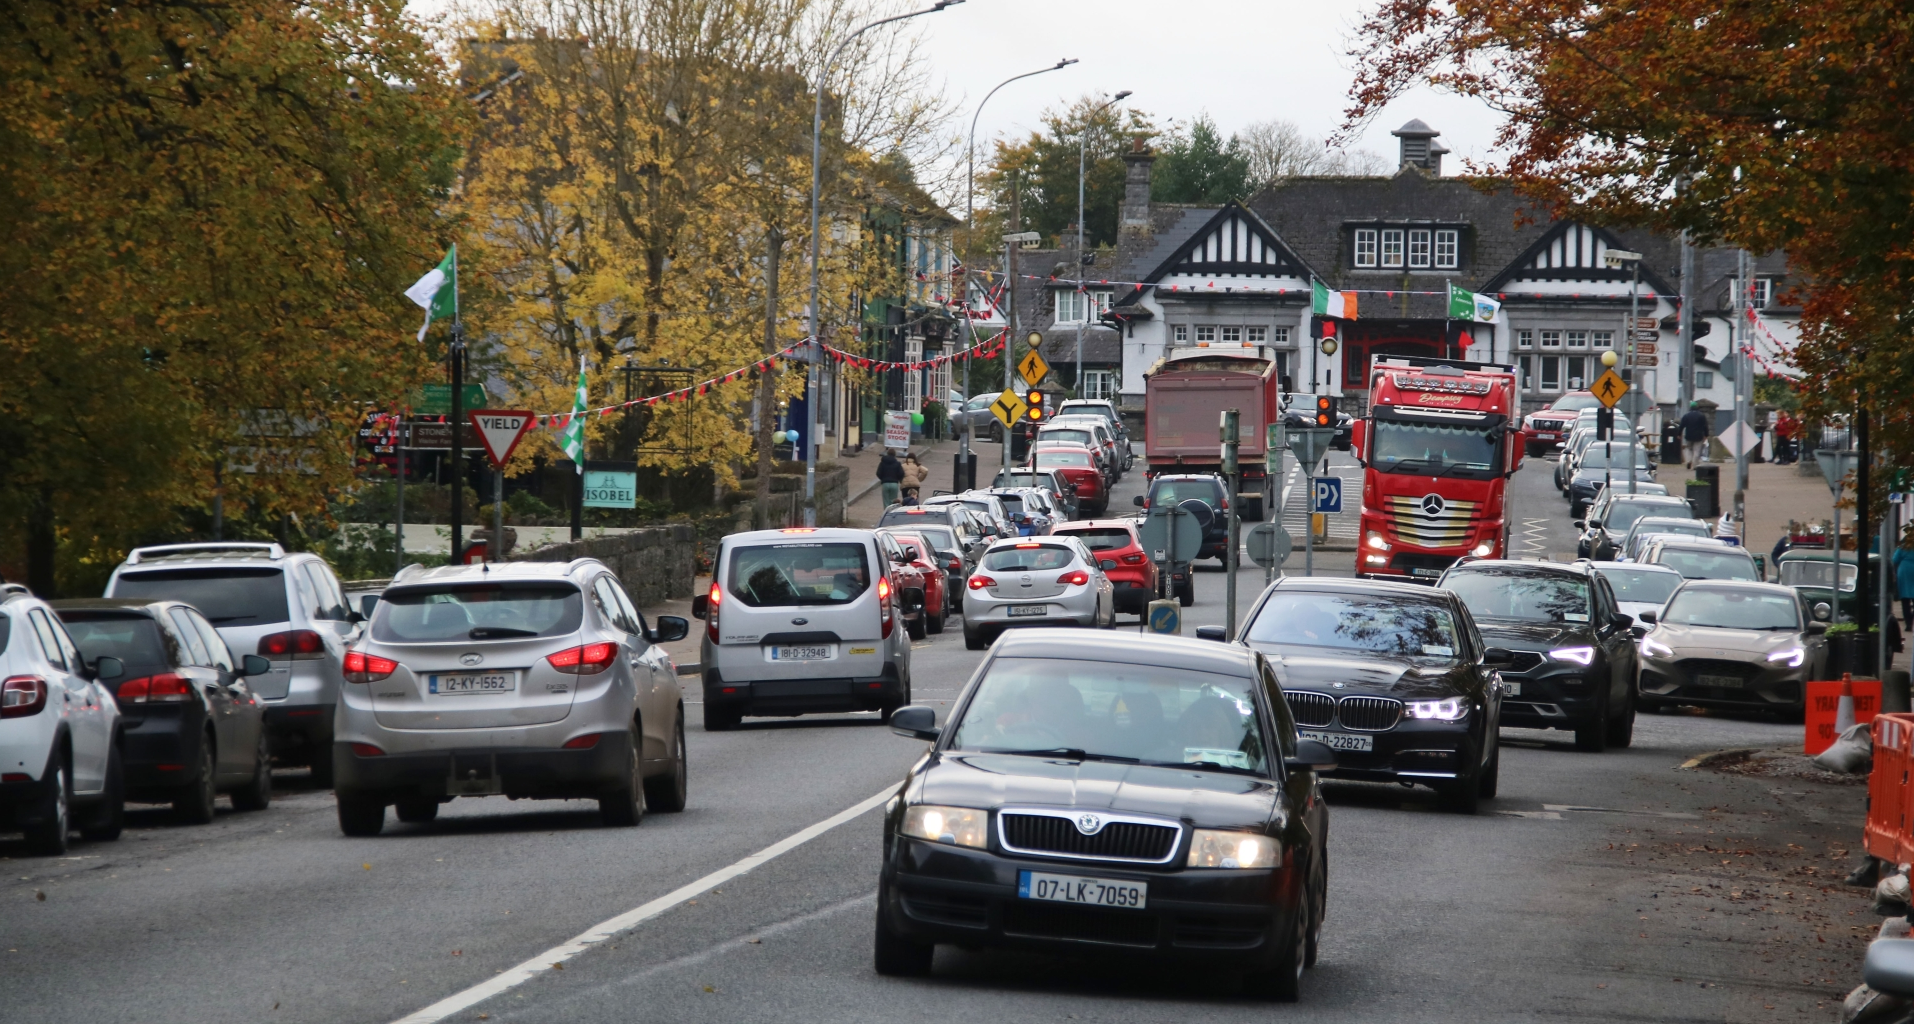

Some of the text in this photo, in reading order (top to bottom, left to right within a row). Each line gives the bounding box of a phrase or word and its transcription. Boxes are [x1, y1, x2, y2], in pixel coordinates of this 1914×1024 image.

[1418, 393, 1463, 404] Dempsey
[482, 418, 521, 430] YIELD
[586, 489, 633, 501] ISOBEL
[1317, 483, 1329, 507] P
[781, 648, 826, 658] 181-D-32948
[445, 676, 505, 691] 12-KY-1562
[1037, 880, 1139, 906] 07-LK-7059
